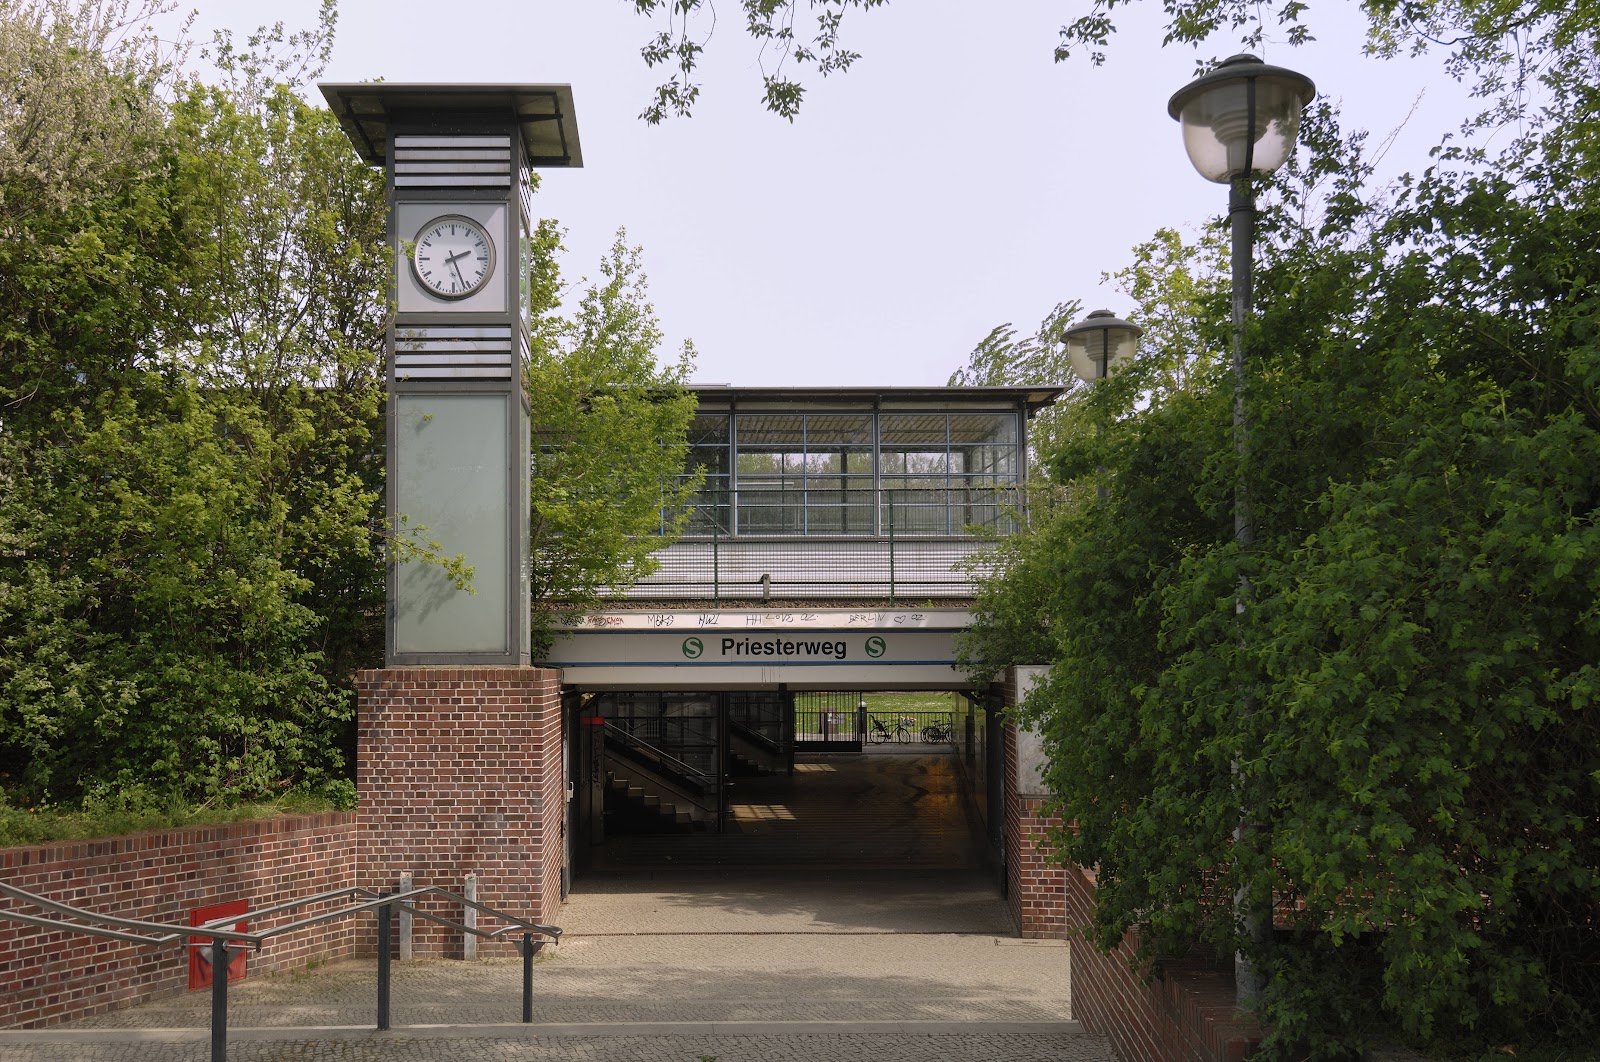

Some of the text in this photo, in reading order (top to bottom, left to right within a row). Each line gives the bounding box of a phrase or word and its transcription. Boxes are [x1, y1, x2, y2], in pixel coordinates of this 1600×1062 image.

[848, 612, 886, 624] BERLIN
[684, 636, 886, 660] S Priesterweg S
